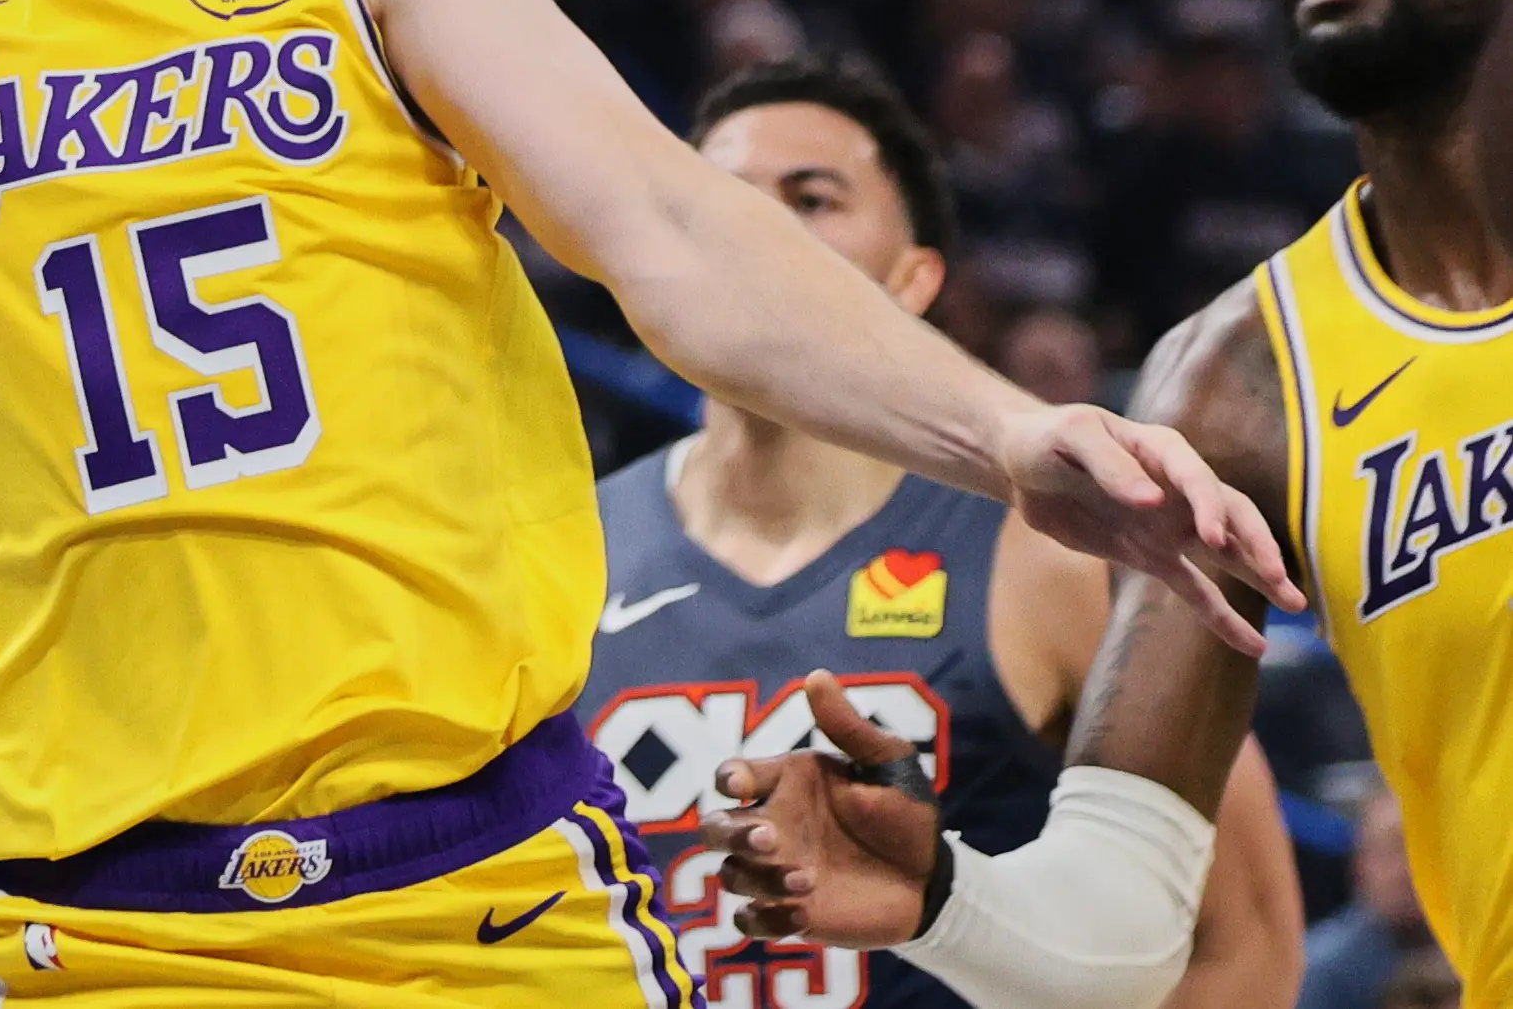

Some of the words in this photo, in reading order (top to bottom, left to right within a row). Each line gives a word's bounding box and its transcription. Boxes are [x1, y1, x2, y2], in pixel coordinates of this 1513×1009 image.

[33, 194, 322, 514] 15
[1355, 419, 1513, 624] LAK
[225, 851, 328, 886] LAKERS
